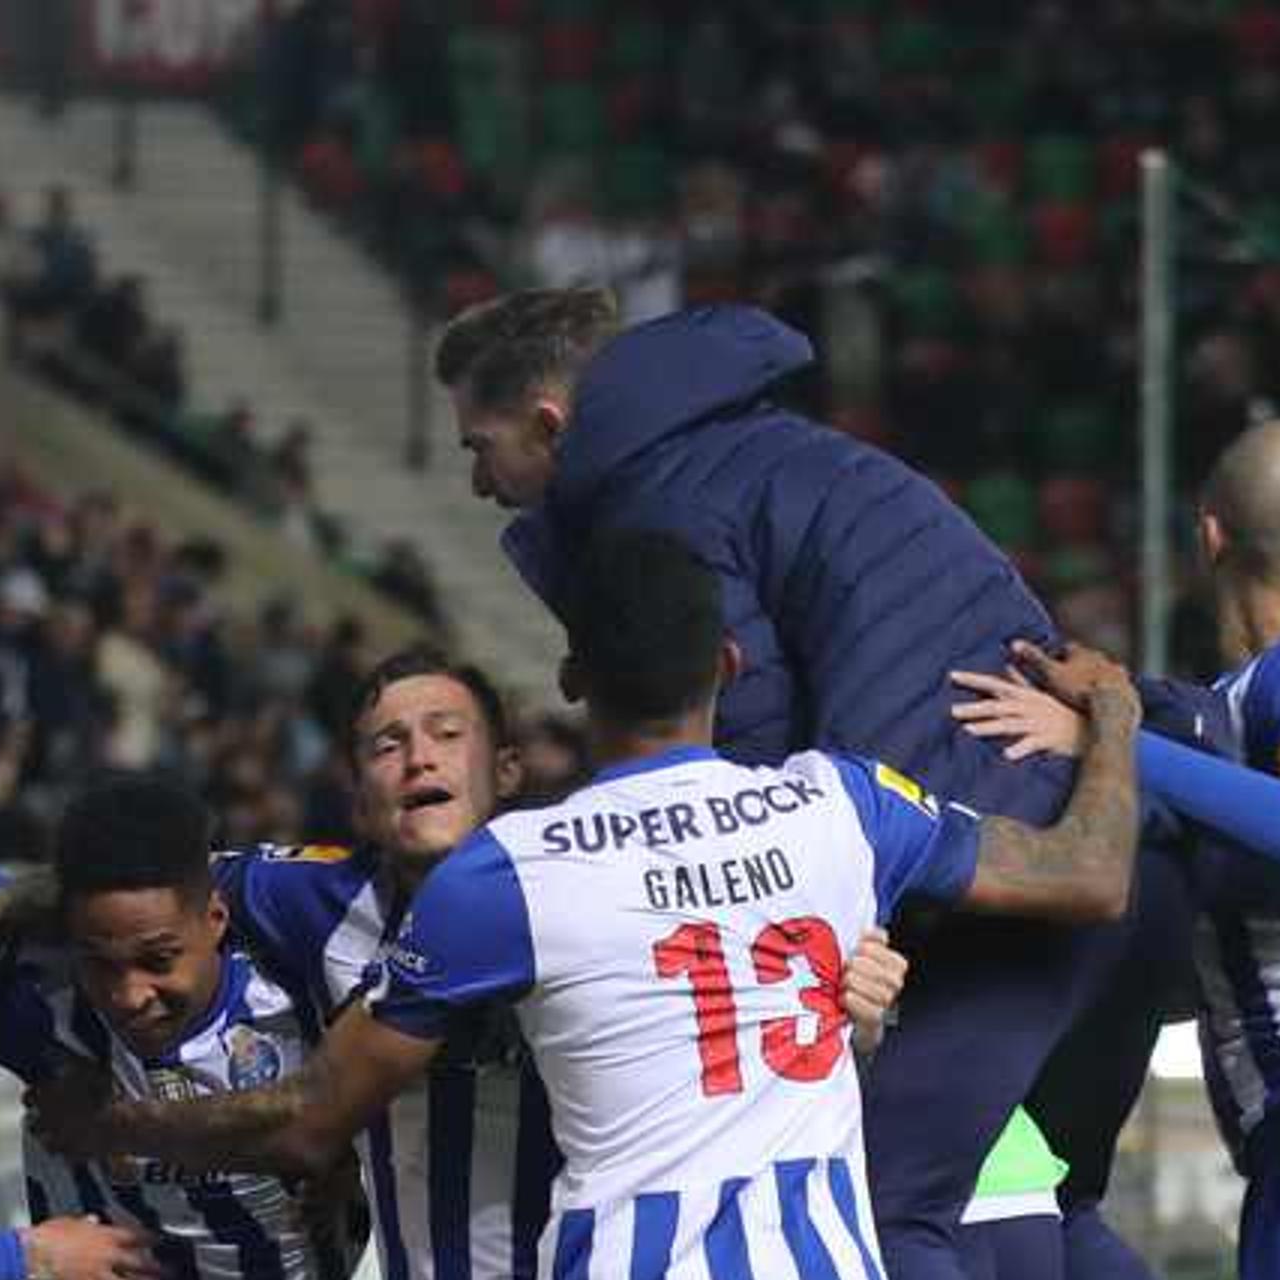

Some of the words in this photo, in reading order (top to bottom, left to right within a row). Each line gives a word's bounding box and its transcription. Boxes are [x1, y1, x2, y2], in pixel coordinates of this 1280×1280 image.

[542, 803, 704, 854] SUPER
[644, 847, 796, 911] GALENO
[652, 916, 850, 1097] 13
